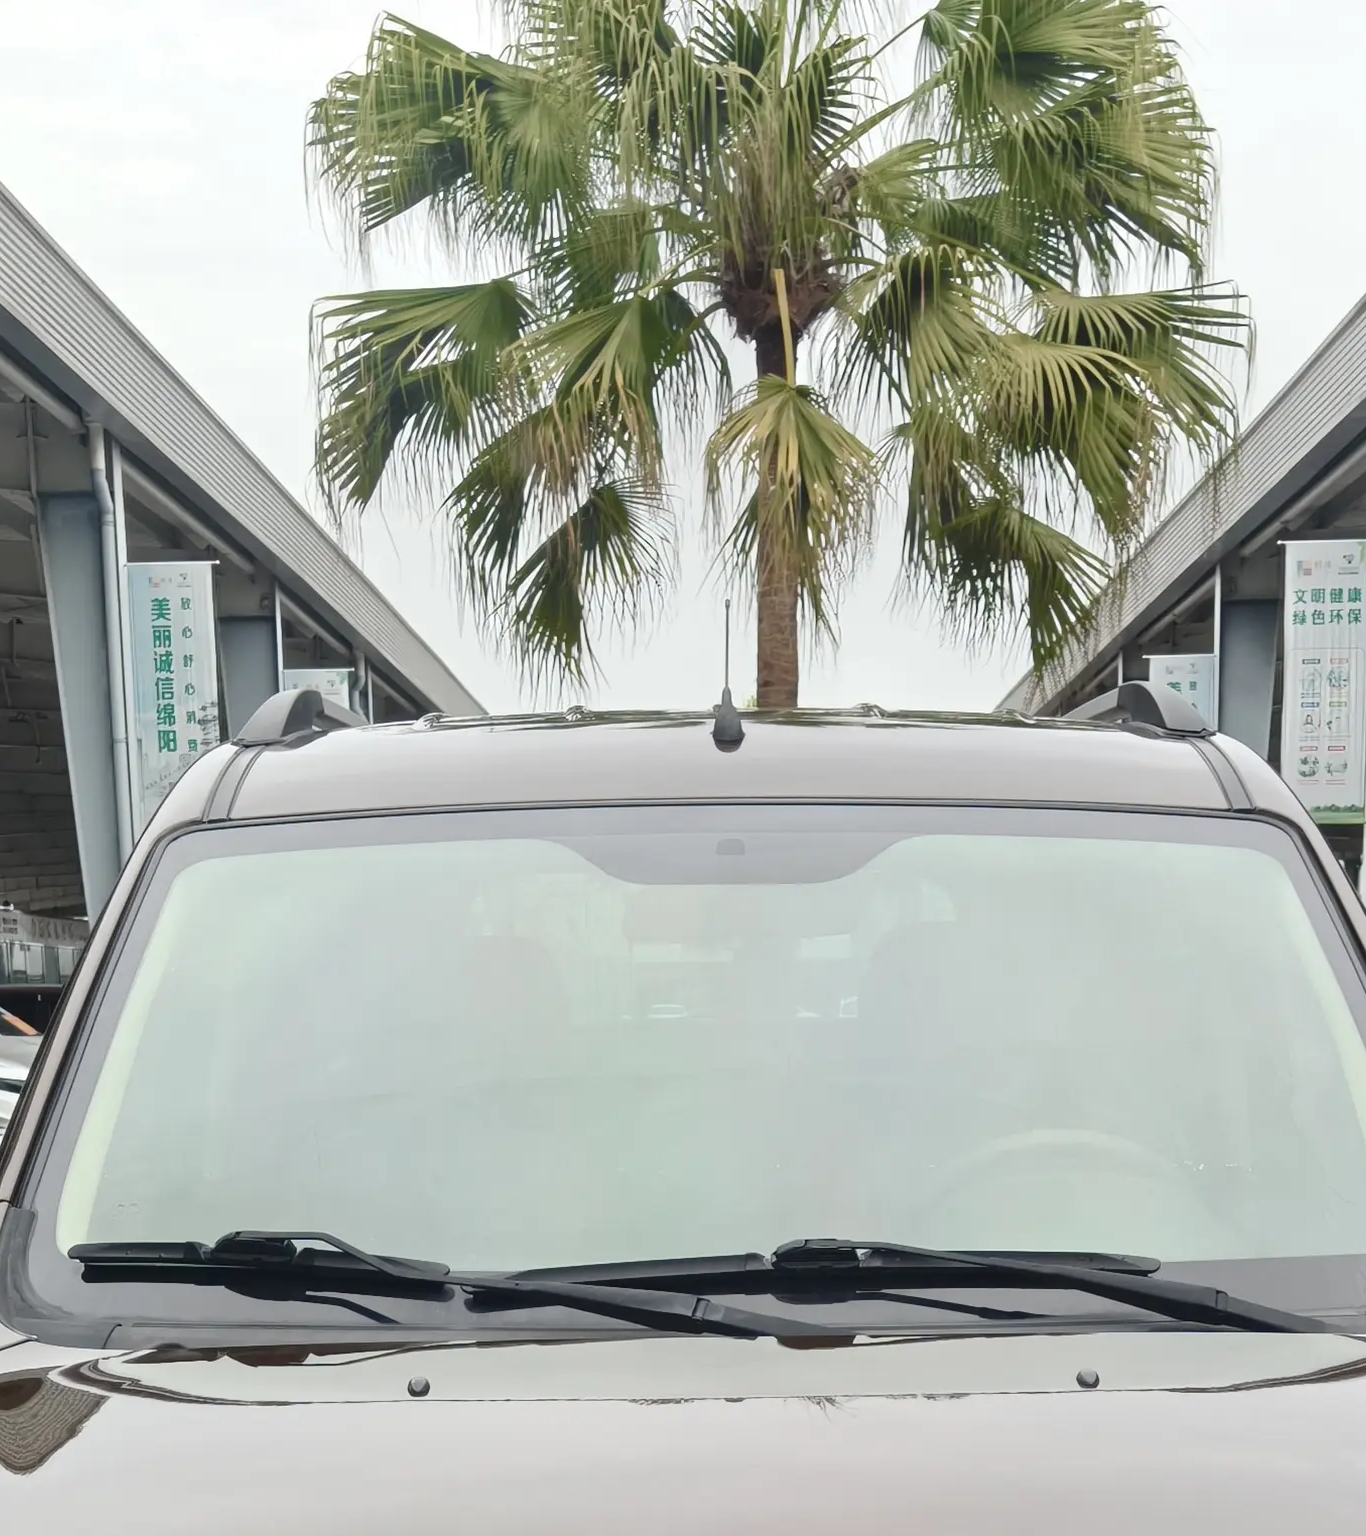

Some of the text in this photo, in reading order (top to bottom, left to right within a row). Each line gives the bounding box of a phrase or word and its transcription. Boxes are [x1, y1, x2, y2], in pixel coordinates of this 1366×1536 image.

[1292, 608, 1362, 626] 绿色环保
[1293, 586, 1362, 605] 文明健康
[151, 597, 178, 753] 美丽诚信绵阳
[181, 597, 198, 752] 放心舒心消费
